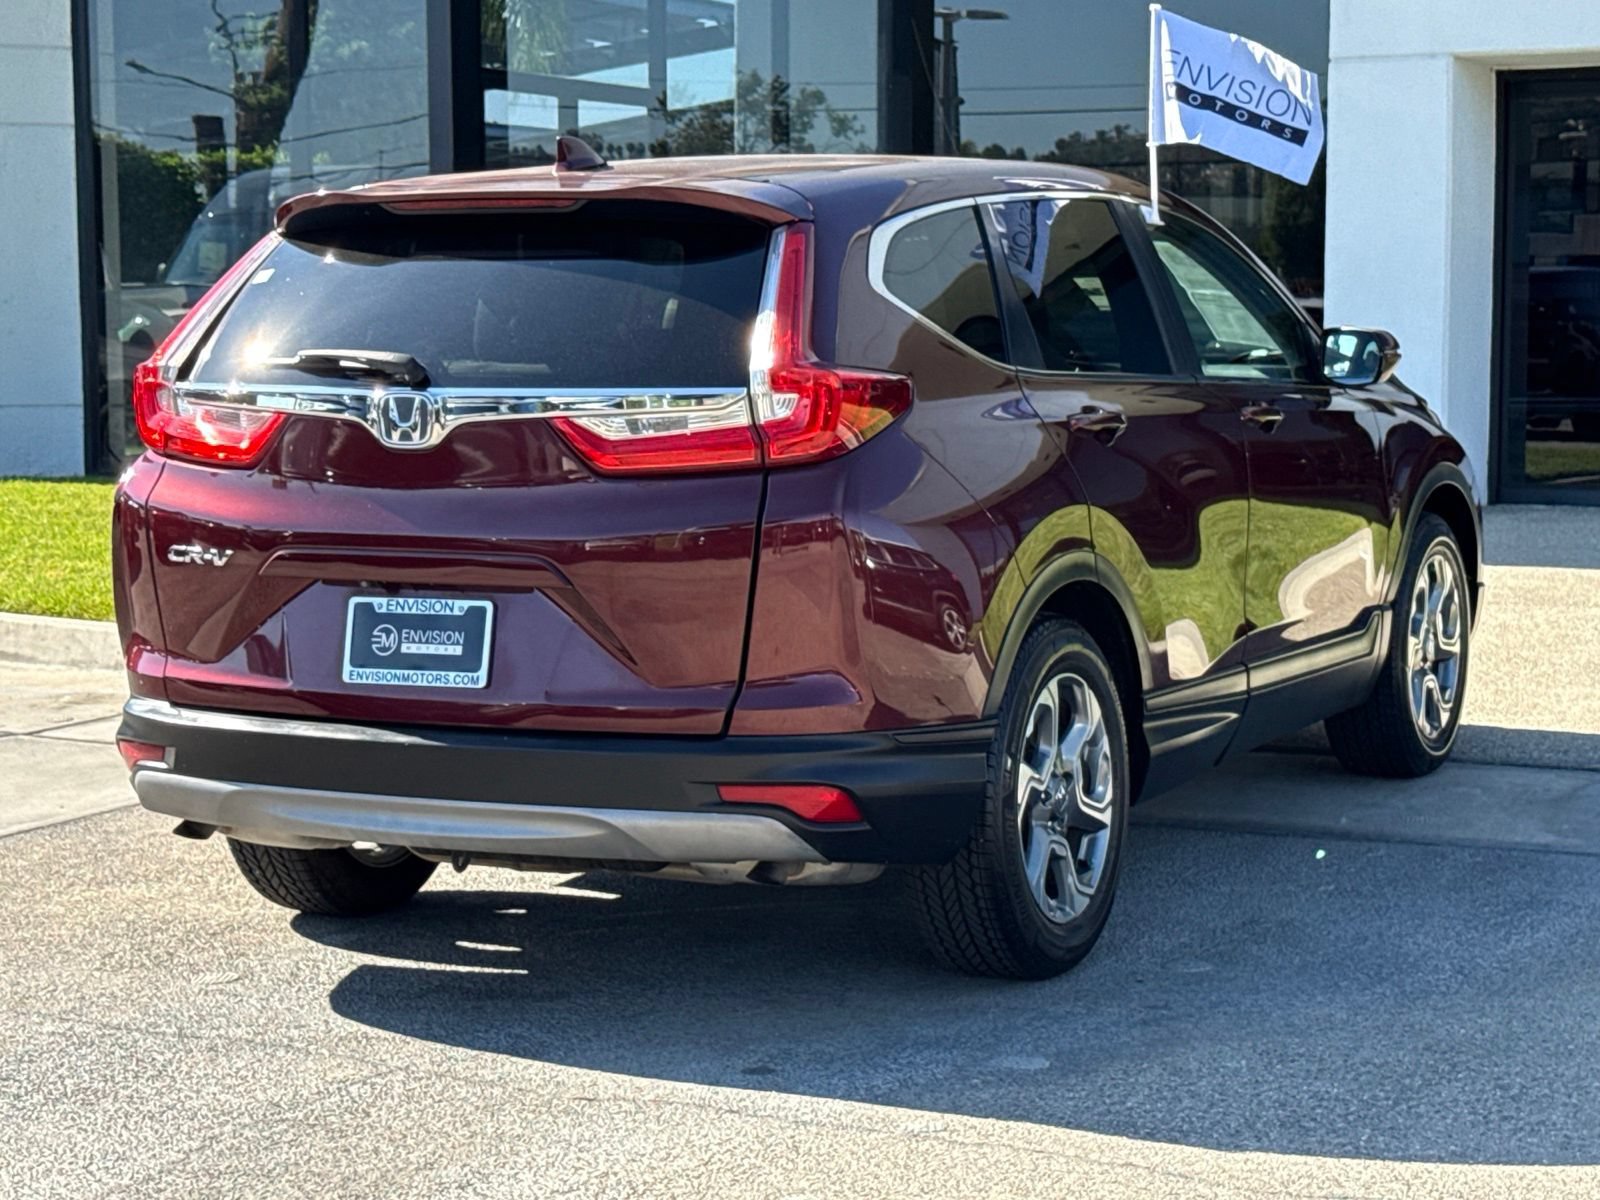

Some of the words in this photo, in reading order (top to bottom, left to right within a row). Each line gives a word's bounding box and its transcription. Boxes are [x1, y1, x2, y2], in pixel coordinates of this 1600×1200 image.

[1167, 83, 1293, 139] OTORS
[168, 544, 234, 567] CR-V
[386, 599, 455, 613] ENVISION
[401, 629, 464, 644] ENVISION
[349, 670, 480, 686] ENVISIONMOTORS.COM
